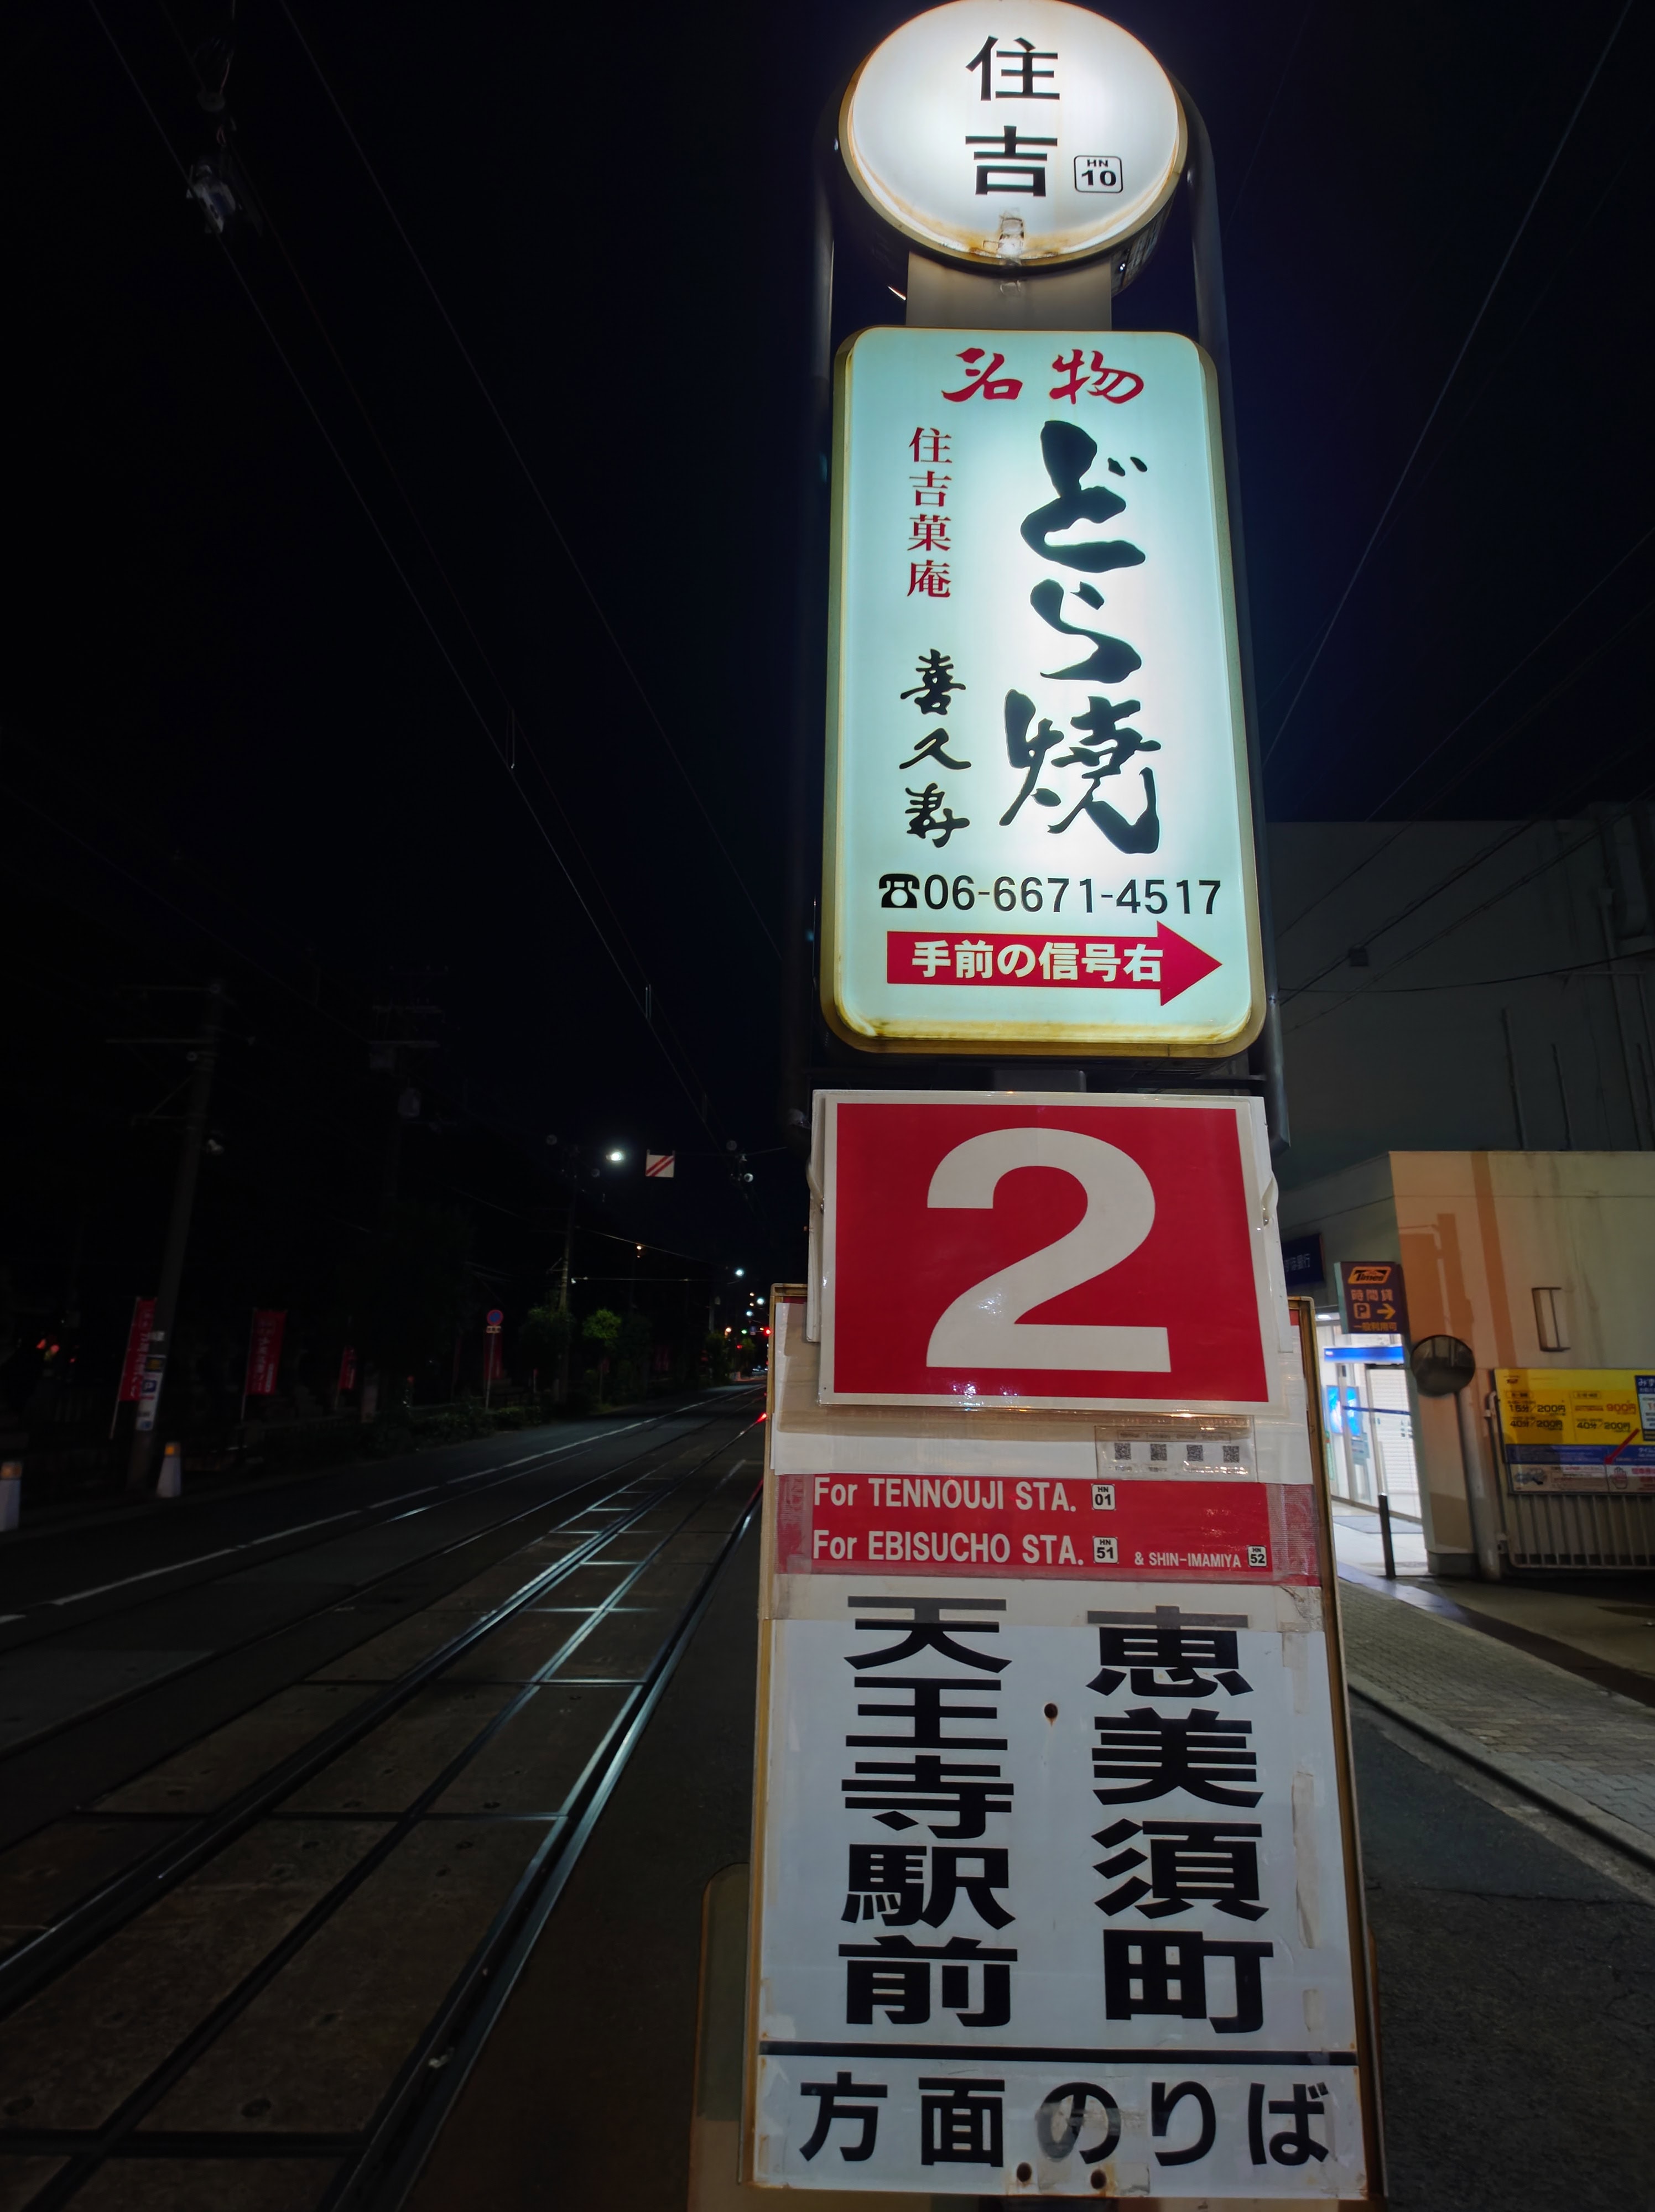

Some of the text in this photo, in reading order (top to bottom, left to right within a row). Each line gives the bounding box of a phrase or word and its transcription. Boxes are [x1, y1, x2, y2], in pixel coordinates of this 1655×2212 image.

[965, 35, 1060, 197] 住吉
[1081, 170, 1116, 186] 10
[942, 347, 1144, 405] 名物
[907, 427, 953, 598] 住吉菓庵
[999, 420, 1162, 854] どら焼
[924, 874, 1221, 915] 06-6671-4517
[912, 940, 1162, 983] 手前の信号右
[927, 1127, 1171, 1373] 2
[814, 1477, 1076, 1512] For TENNOUJI STA.
[1095, 1494, 1111, 1506] 01
[813, 1530, 1084, 1566] For EBISUCHO STA.
[1096, 1547, 1113, 1559] 51
[1134, 1552, 1241, 1567] & SHIN-IMAMIYA
[1250, 1553, 1266, 1564] 52
[838, 1595, 1018, 2028] 天王寺駅前
[1086, 1605, 1274, 2034] 恵美須町
[799, 2071, 1329, 2167] 方面のりば
